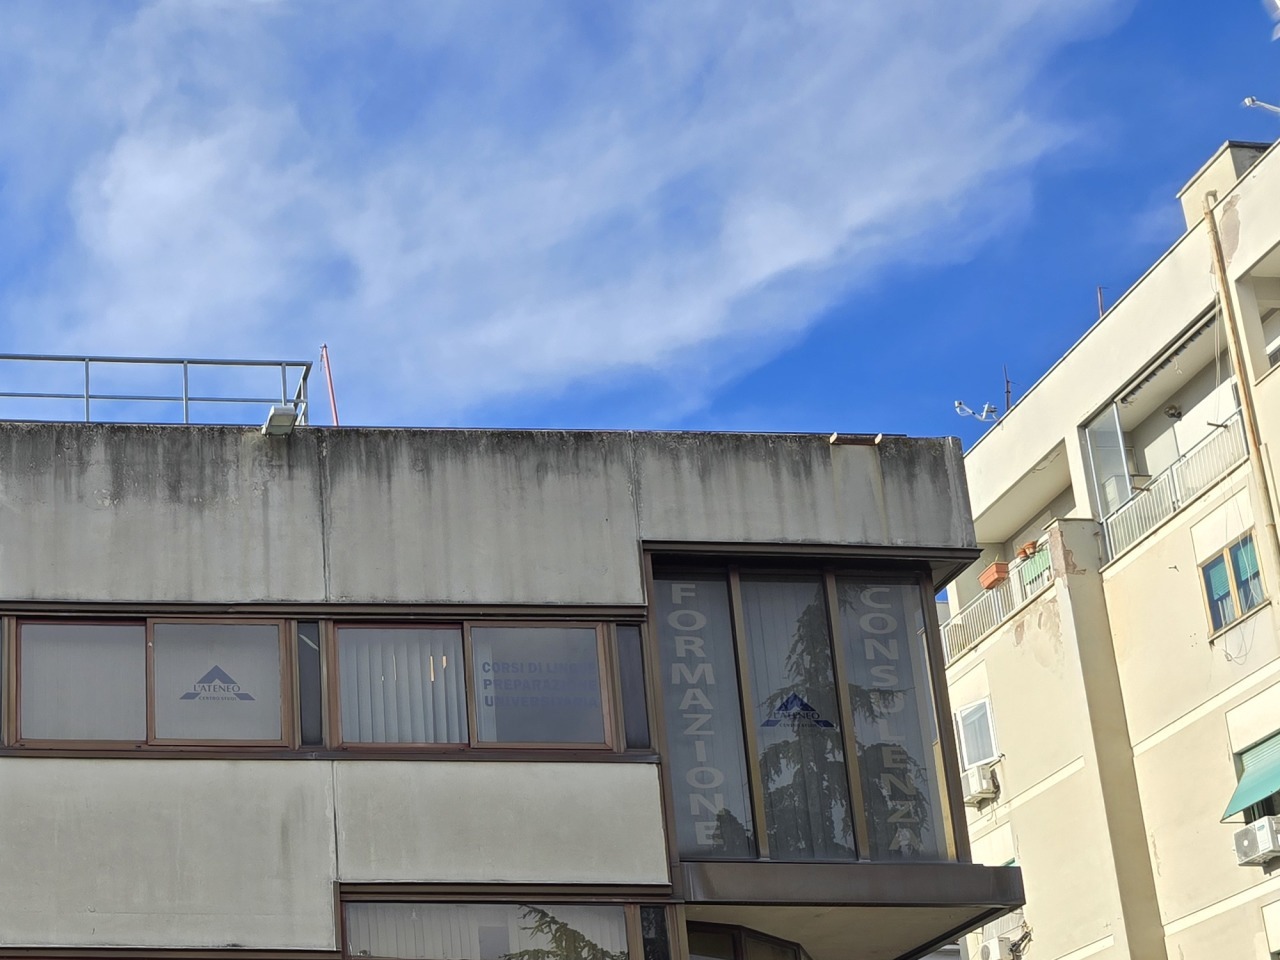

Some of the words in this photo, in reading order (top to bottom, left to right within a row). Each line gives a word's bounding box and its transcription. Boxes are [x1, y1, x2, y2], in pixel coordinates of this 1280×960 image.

[482, 662, 524, 673] CORSI
[528, 662, 542, 674] DI
[193, 684, 241, 693] L'ATENEO
[668, 583, 725, 845] FORMAZIONE
